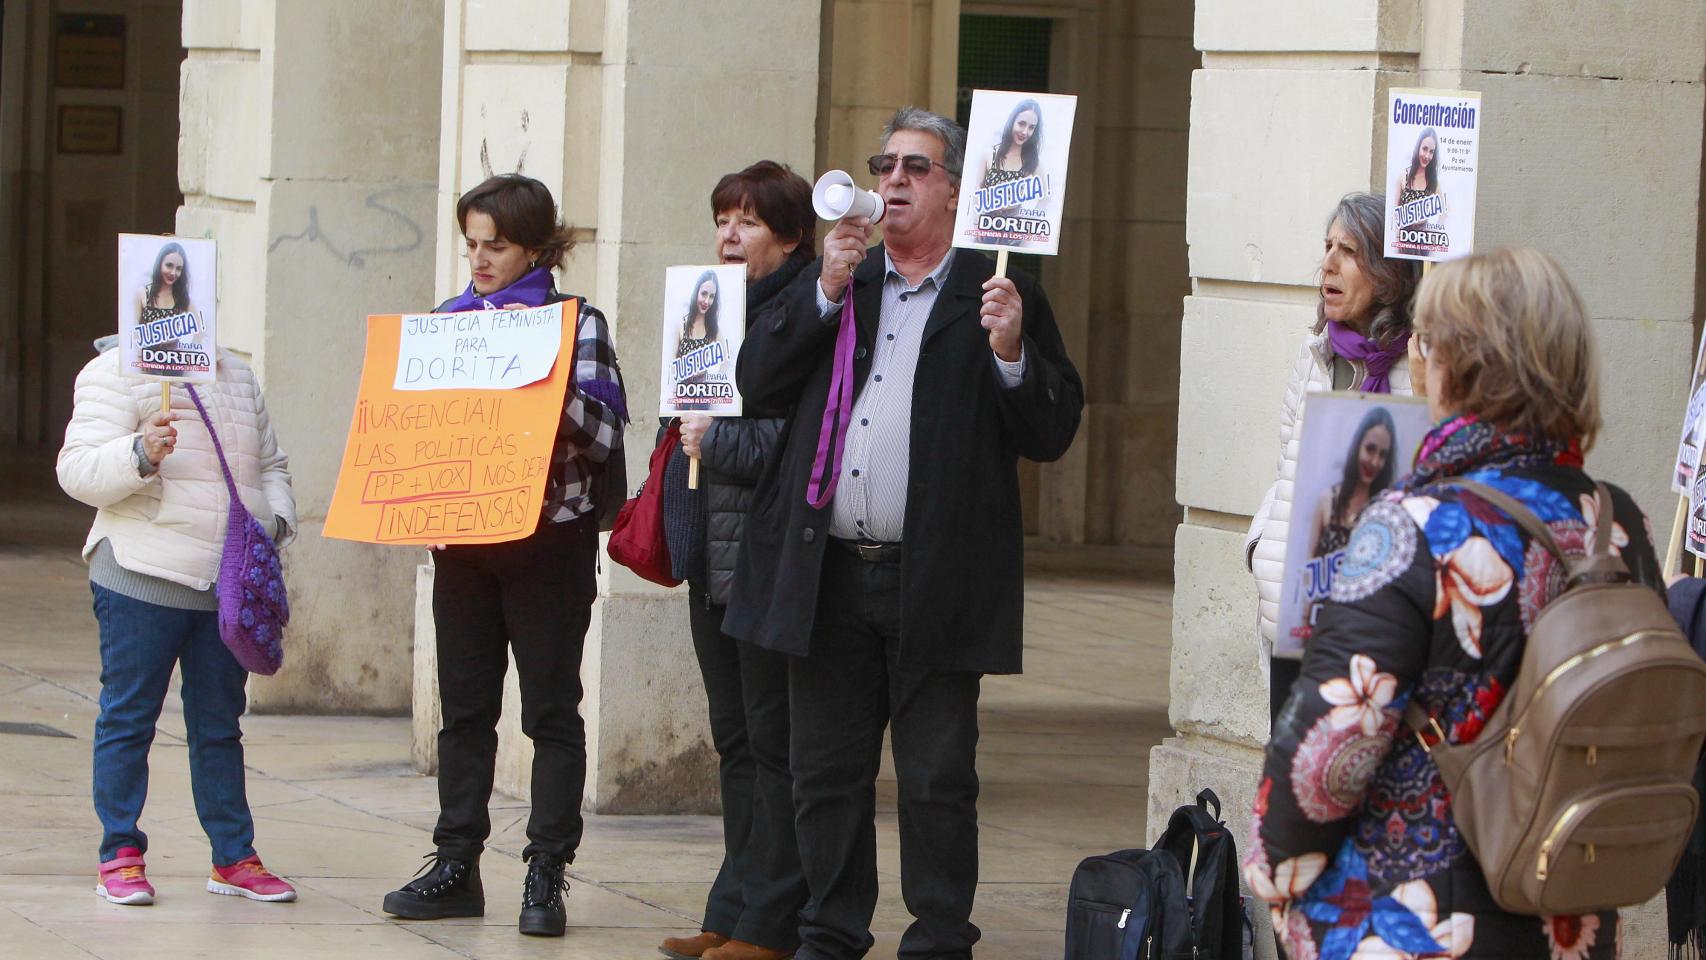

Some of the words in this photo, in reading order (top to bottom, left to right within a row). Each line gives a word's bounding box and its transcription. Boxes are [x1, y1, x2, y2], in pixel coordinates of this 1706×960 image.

[1393, 98, 1476, 129] Concentración
[1020, 208, 1046, 217] PARA
[979, 214, 1051, 236] DORITA
[1399, 229, 1449, 247] DORITA
[408, 314, 480, 336] JUSTICIA
[491, 309, 555, 331] FEMINISTA
[142, 348, 210, 367] DORITA
[455, 337, 488, 355] PARA
[405, 354, 522, 384] DORITA
[676, 382, 733, 398] DORITA
[354, 443, 397, 468] LAS
[415, 433, 518, 462] POLITICAS
[374, 474, 404, 497] PP
[410, 476, 422, 493] +
[428, 466, 466, 492] VOX
[483, 463, 516, 487] NOS
[390, 490, 527, 536] INDEFENSAS
